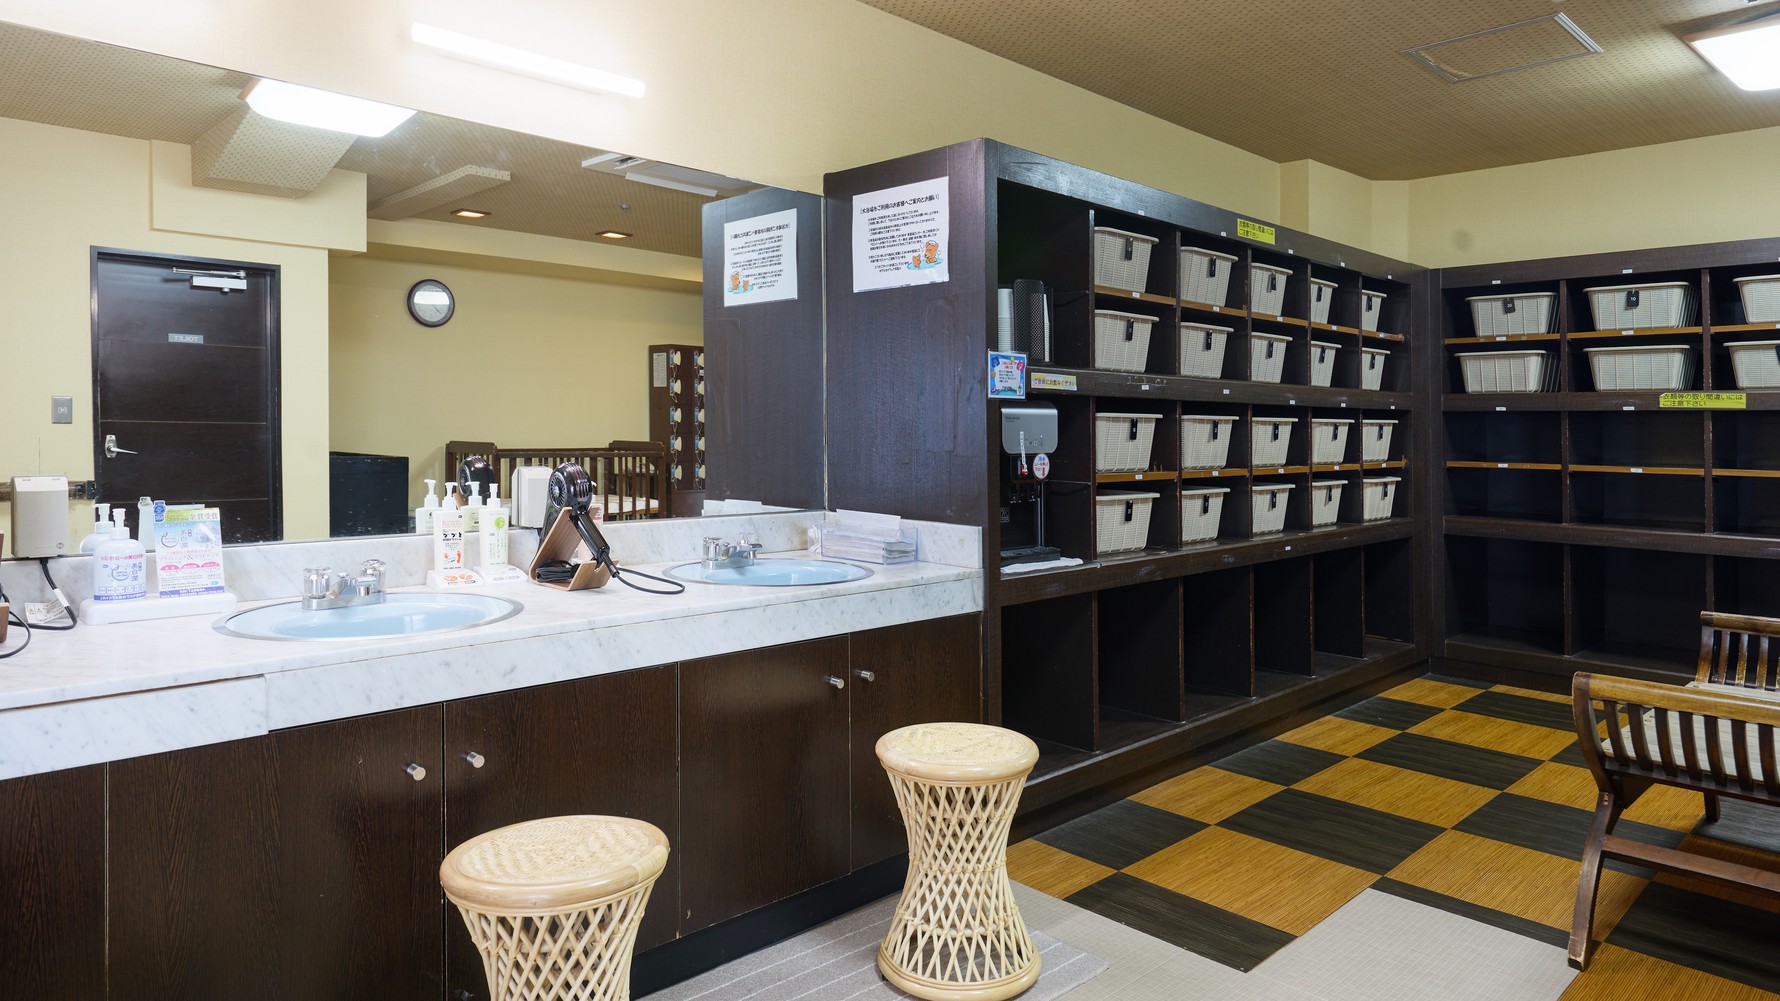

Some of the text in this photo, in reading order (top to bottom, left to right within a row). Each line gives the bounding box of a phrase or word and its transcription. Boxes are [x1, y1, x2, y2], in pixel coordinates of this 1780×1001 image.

[1034, 379, 1076, 387] ご自由にお飲みください
[1663, 393, 1744, 401] 衣類等の取り間違いには
